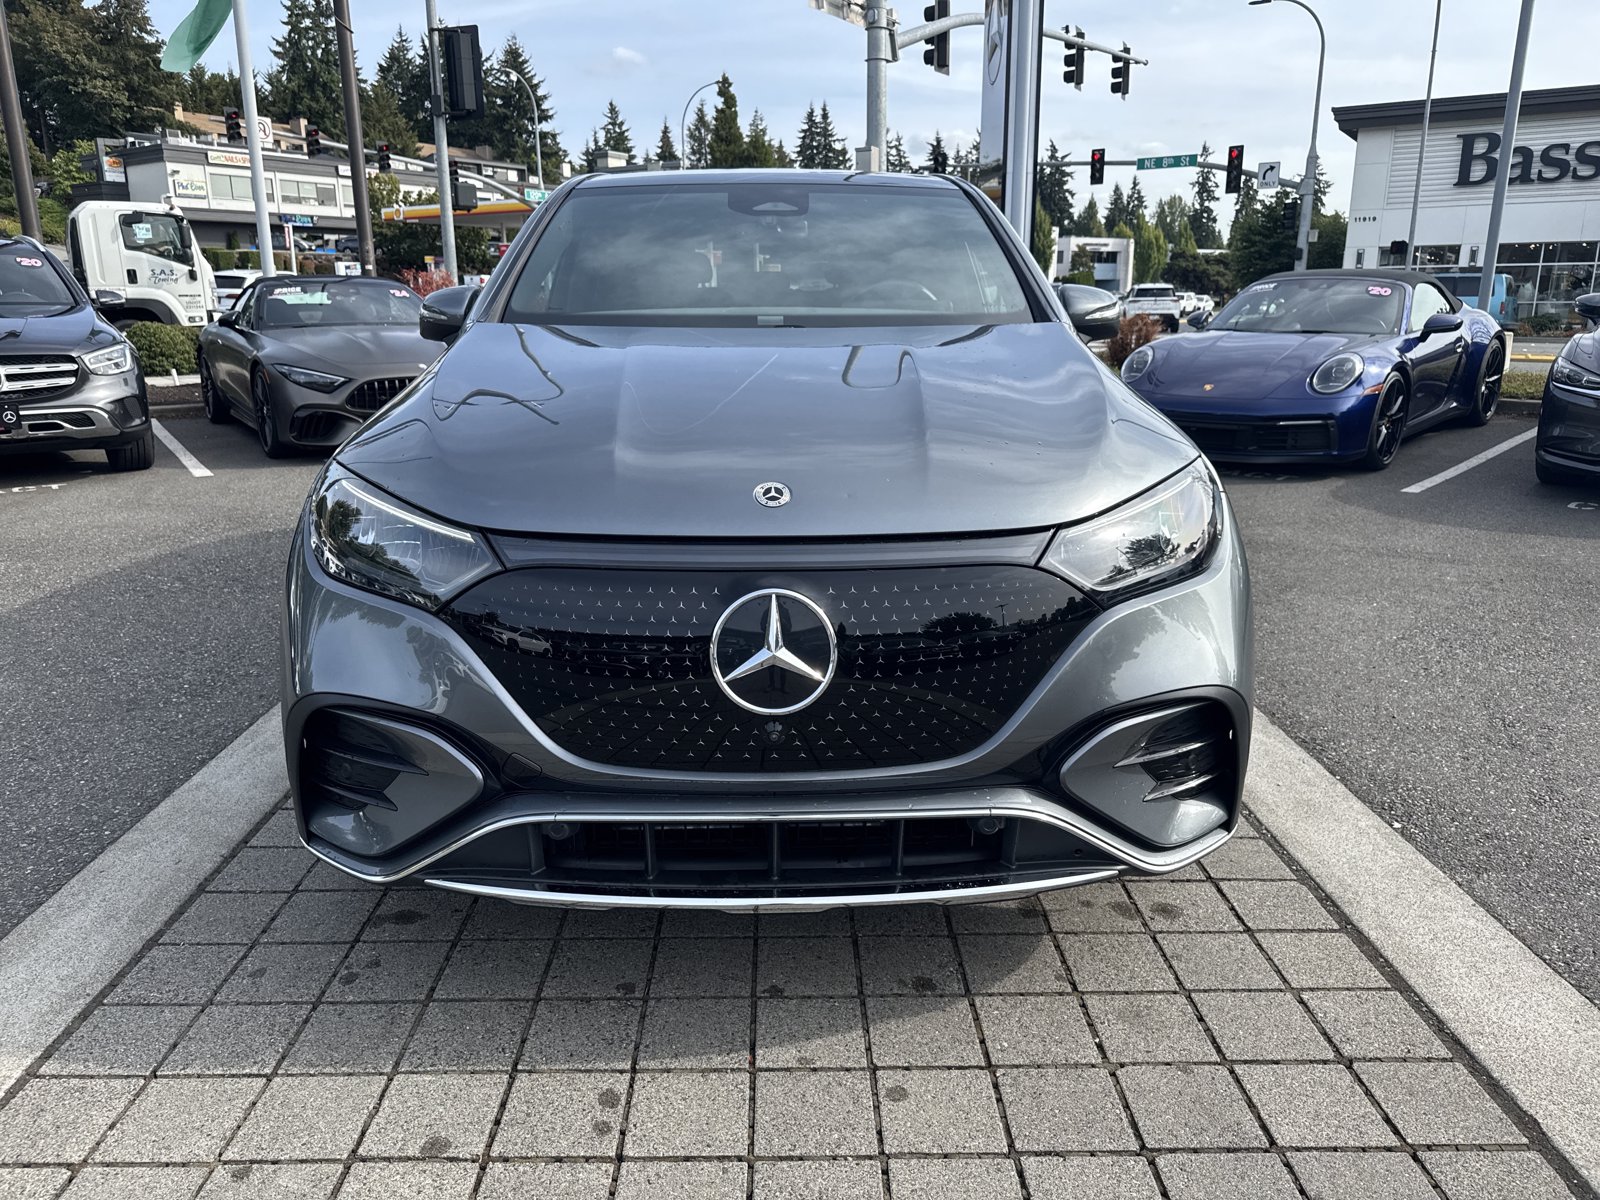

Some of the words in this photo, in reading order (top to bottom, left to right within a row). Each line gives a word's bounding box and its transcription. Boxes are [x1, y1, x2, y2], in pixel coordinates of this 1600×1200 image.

[1145, 159, 1156, 169] NE
[1162, 157, 1174, 168] 8th
[1180, 156, 1190, 166] St
